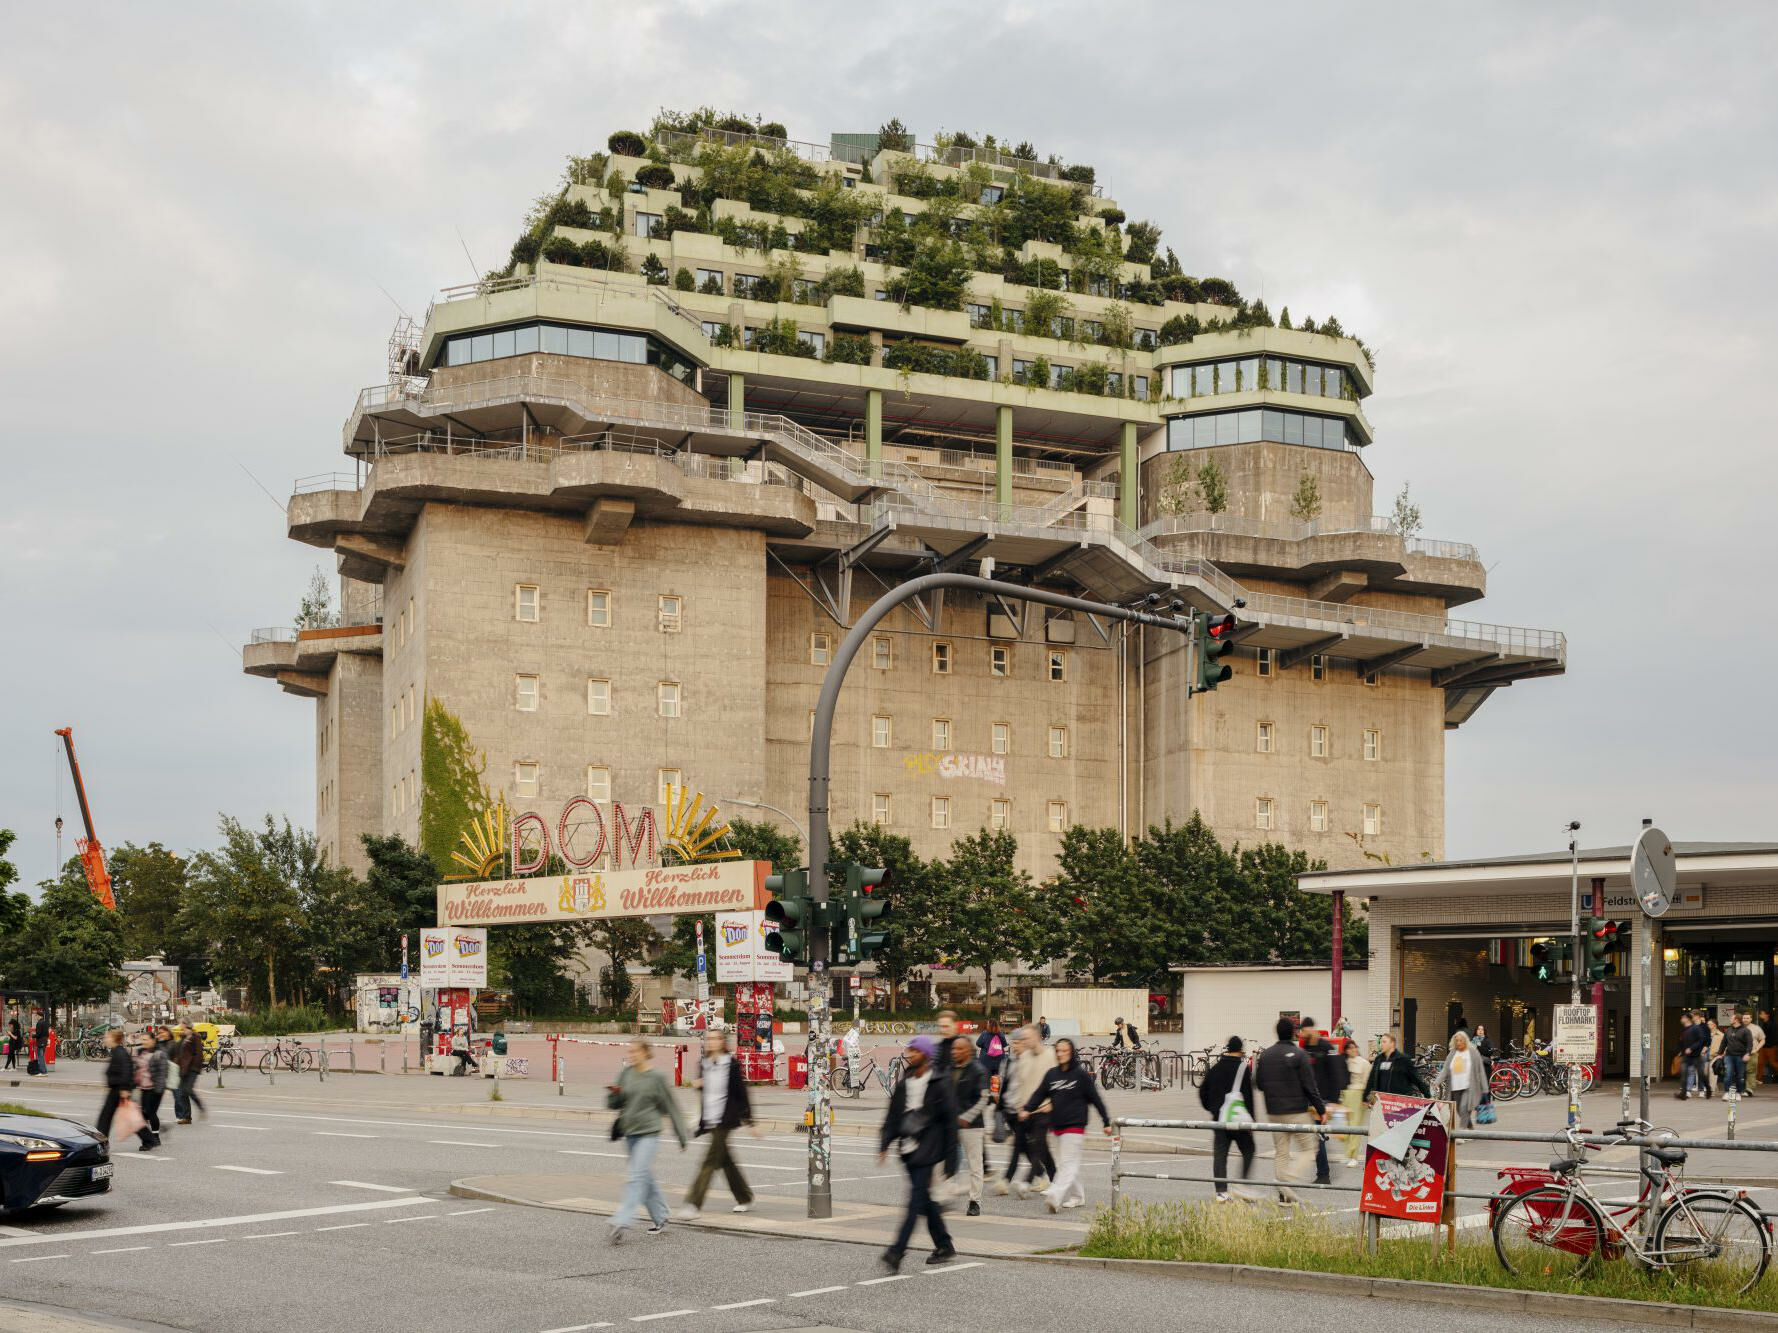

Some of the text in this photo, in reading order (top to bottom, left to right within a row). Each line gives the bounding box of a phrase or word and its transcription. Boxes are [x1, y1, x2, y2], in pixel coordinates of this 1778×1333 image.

[512, 796, 656, 873] DOM
[646, 866, 721, 887] Herzlich
[466, 882, 527, 898] Herzlich
[620, 887, 745, 911] Willkommen
[445, 900, 548, 921] Willkommen
[1603, 896, 1637, 906] Feldstr
[1558, 1016, 1596, 1025] FLOHMARKT
